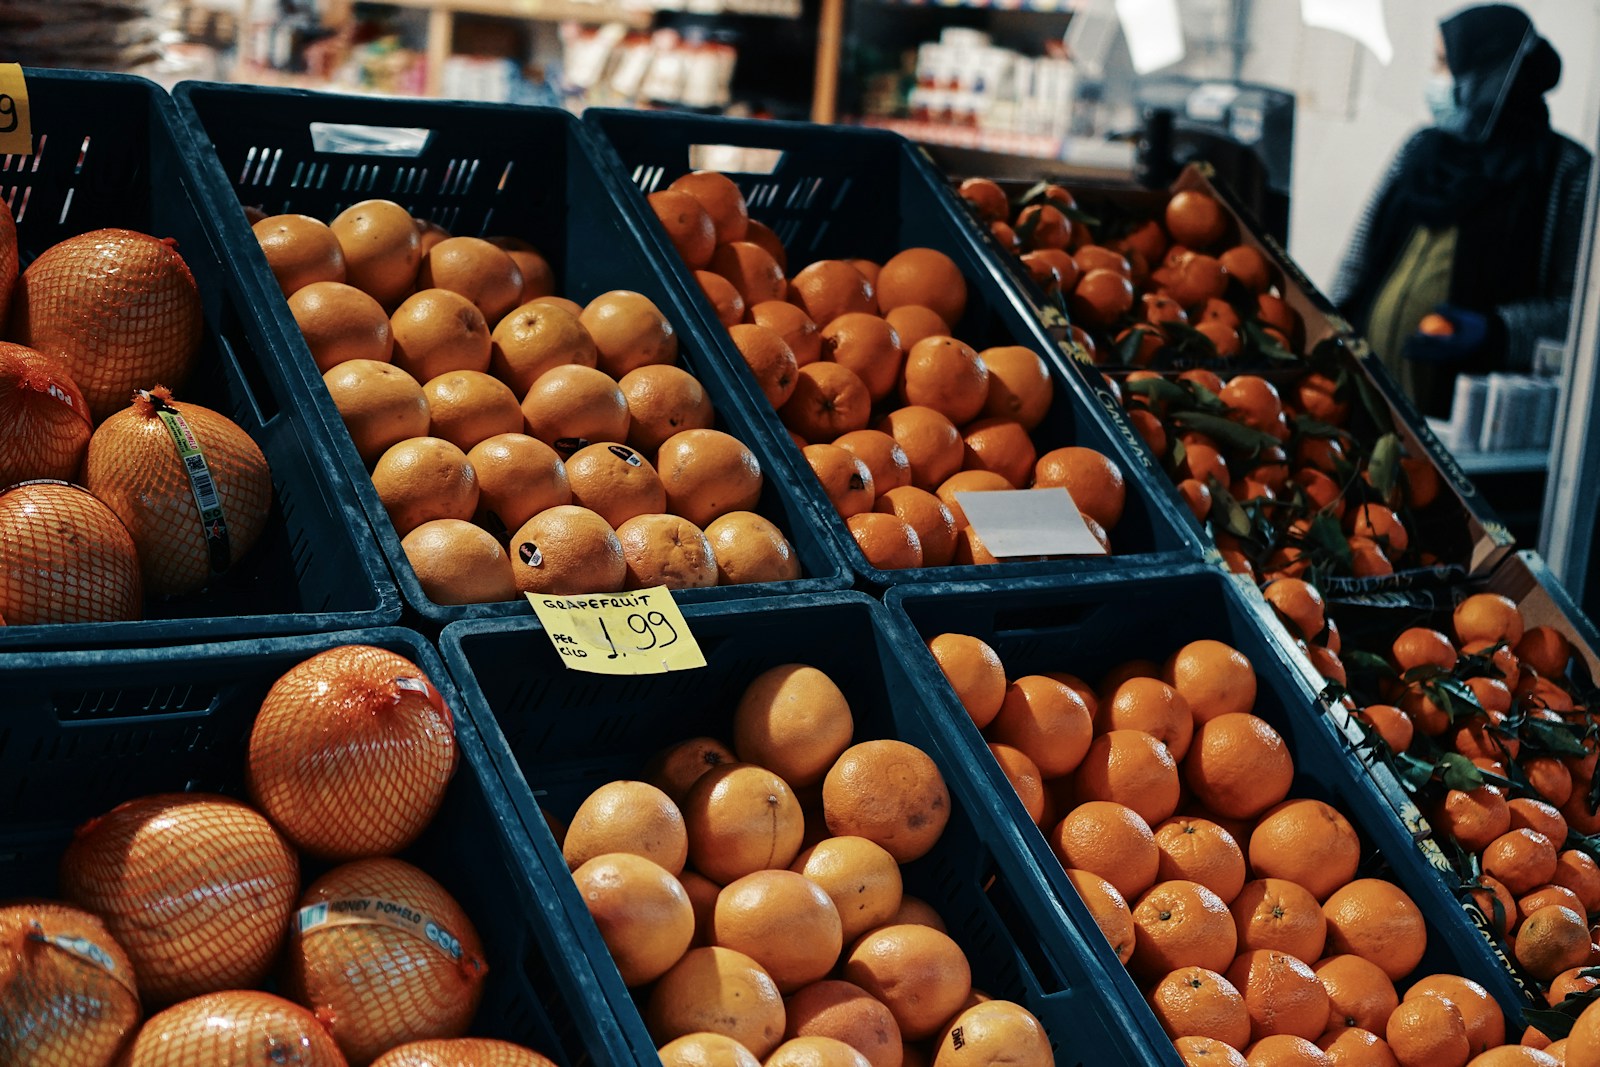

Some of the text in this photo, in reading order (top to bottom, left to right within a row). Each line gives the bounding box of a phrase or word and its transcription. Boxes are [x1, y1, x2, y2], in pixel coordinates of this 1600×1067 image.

[1095, 388, 1152, 467] GAUDIAS
[184, 429, 199, 450] POMELO
[543, 593, 651, 610] GRAPEFRUIT
[552, 633, 579, 644] PER
[331, 900, 371, 913] HONEY
[376, 901, 421, 924] POMELO
[951, 1027, 964, 1051] UNO
